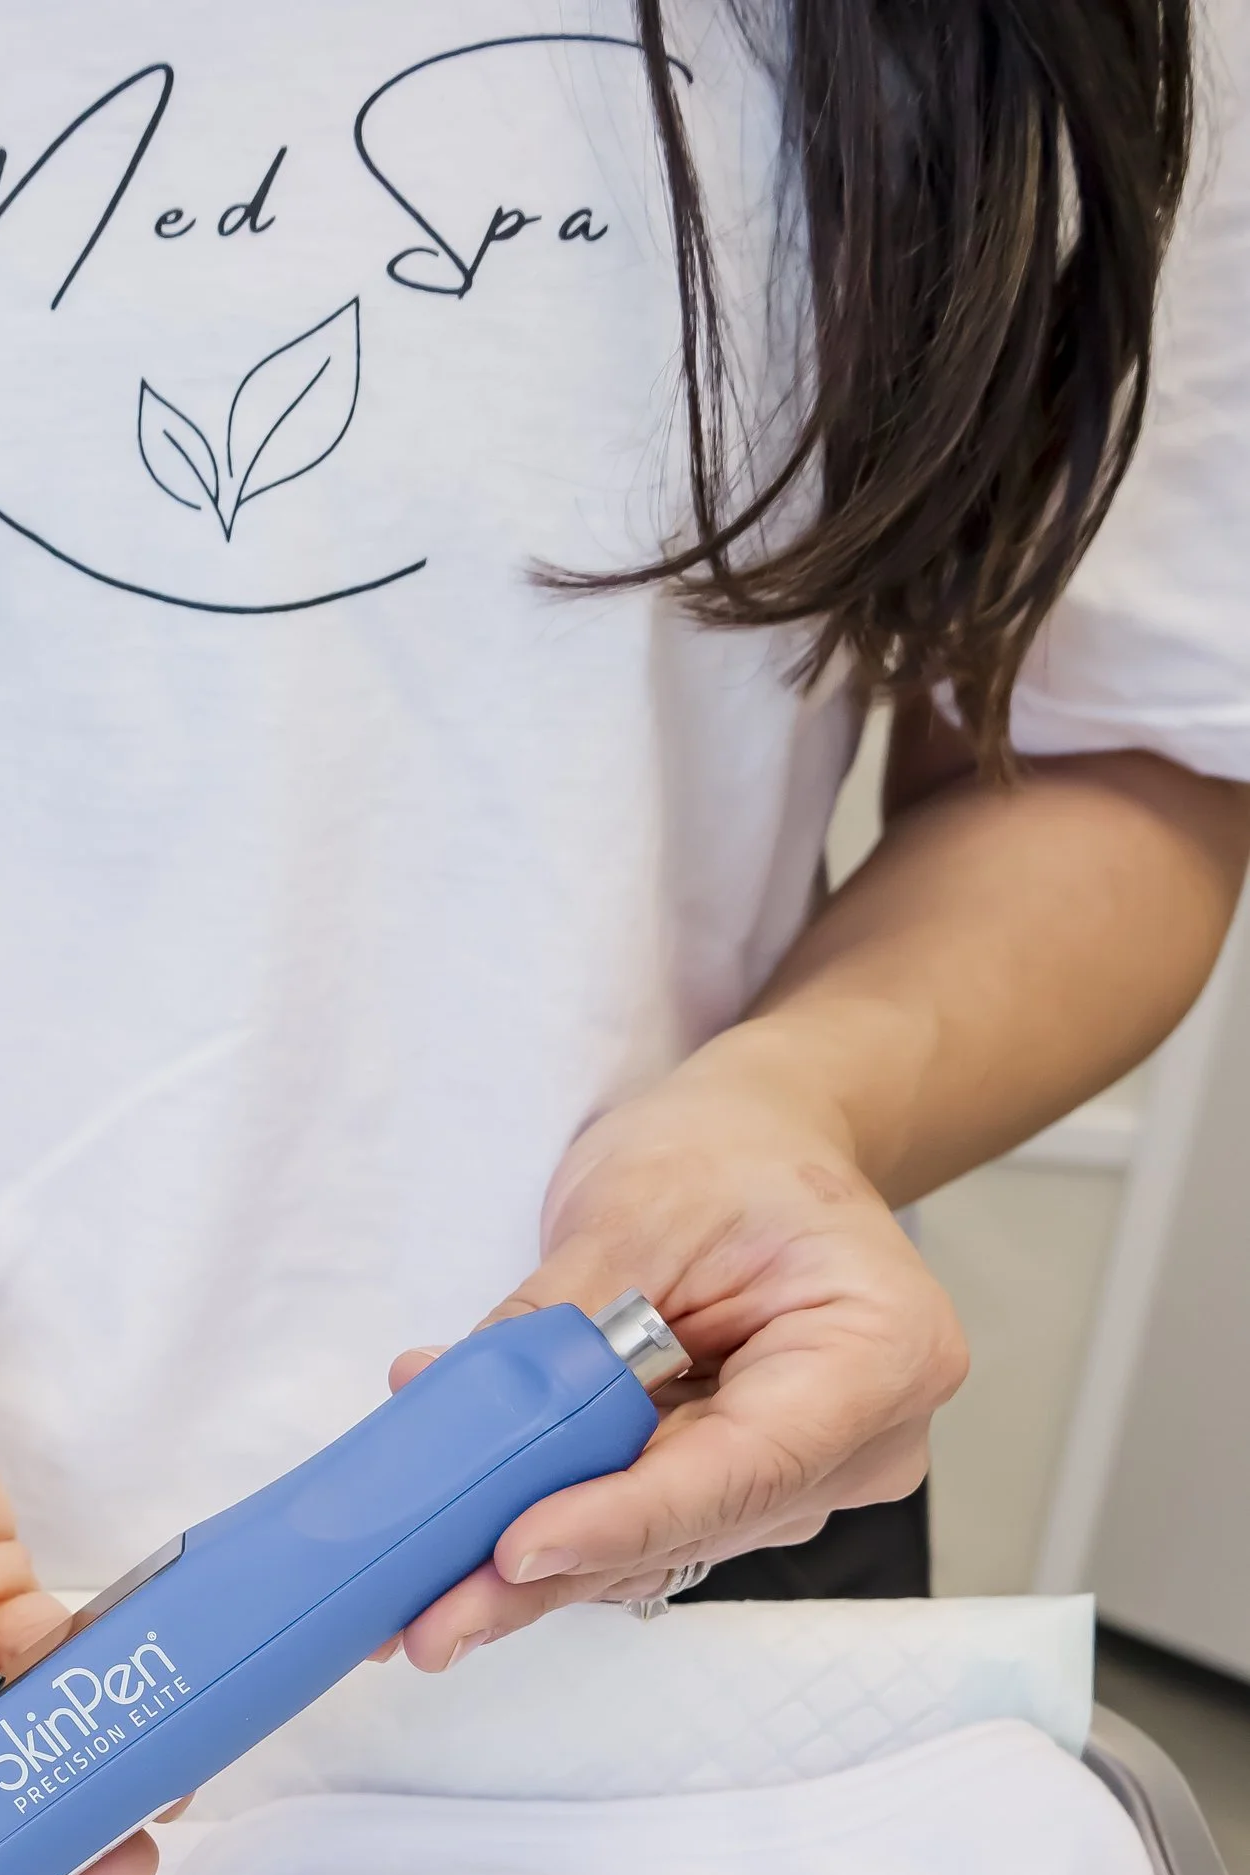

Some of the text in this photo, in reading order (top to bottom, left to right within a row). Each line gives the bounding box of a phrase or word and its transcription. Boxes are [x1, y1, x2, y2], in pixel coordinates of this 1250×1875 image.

[353, 33, 695, 299] Spa
[13, 1675, 191, 1814] PRECISION ELITE
